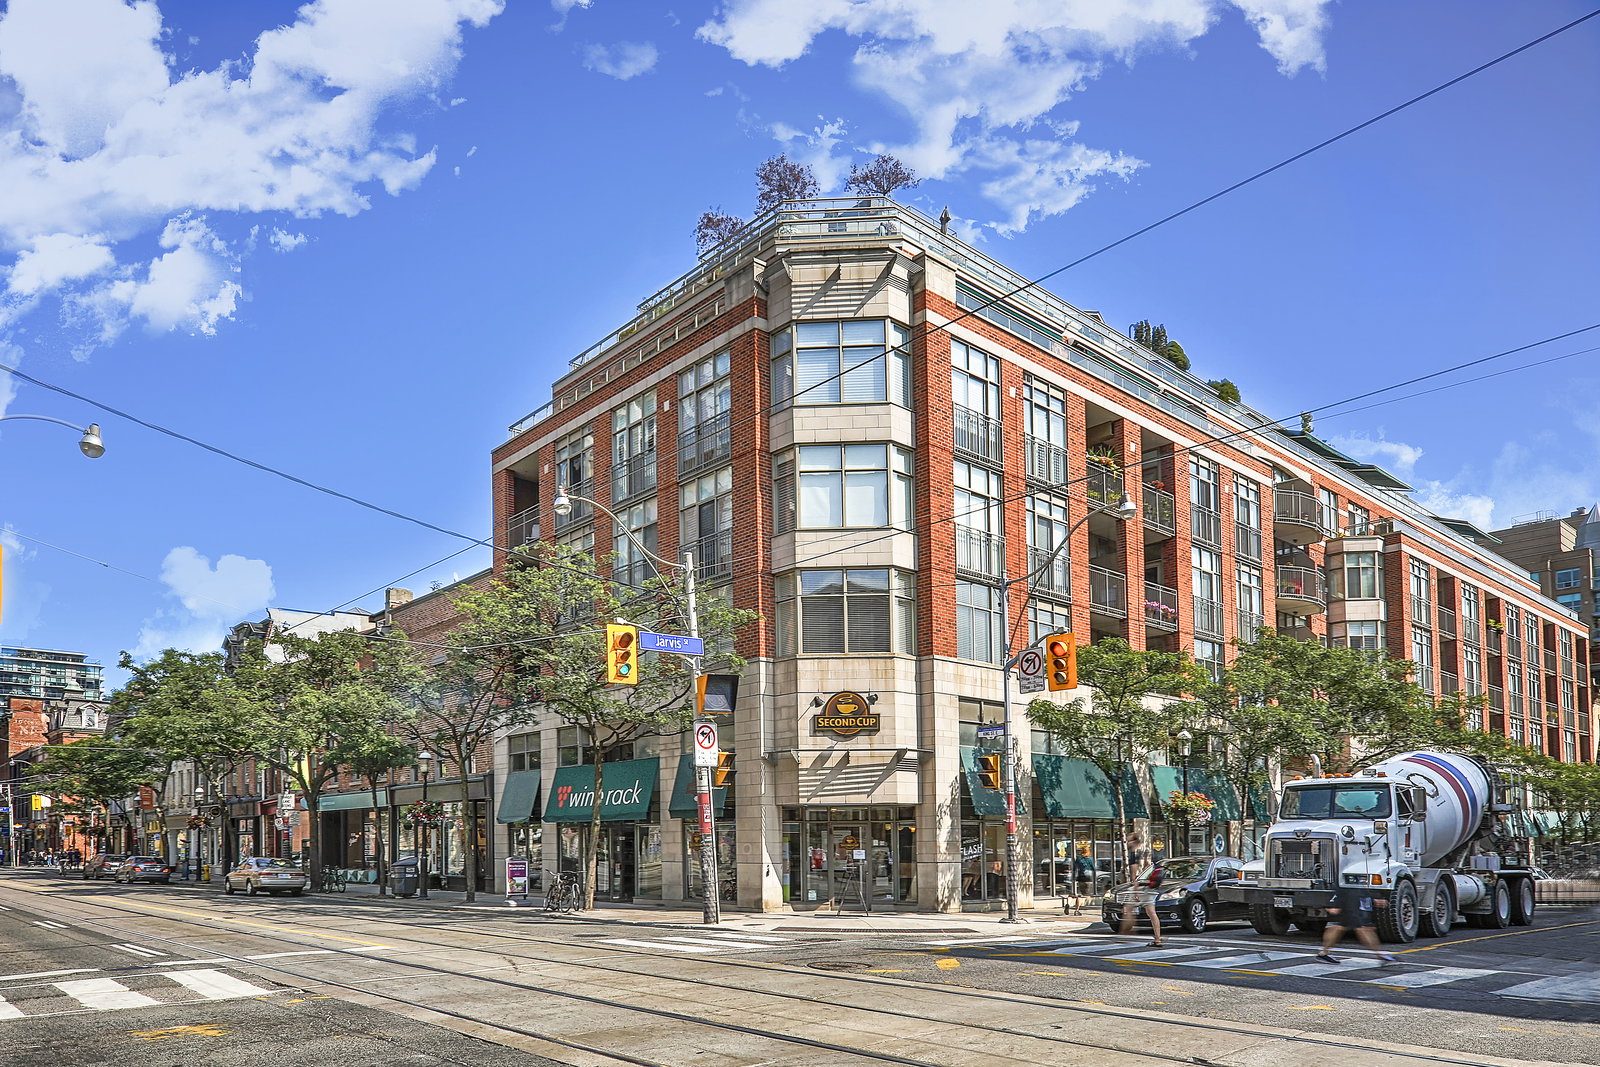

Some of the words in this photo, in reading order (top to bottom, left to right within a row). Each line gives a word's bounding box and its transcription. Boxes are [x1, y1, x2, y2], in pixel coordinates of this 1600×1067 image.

[655, 635, 682, 649] Jarvis
[817, 717, 856, 727] SECOND
[856, 717, 876, 727] CUP
[604, 779, 643, 806] rack
